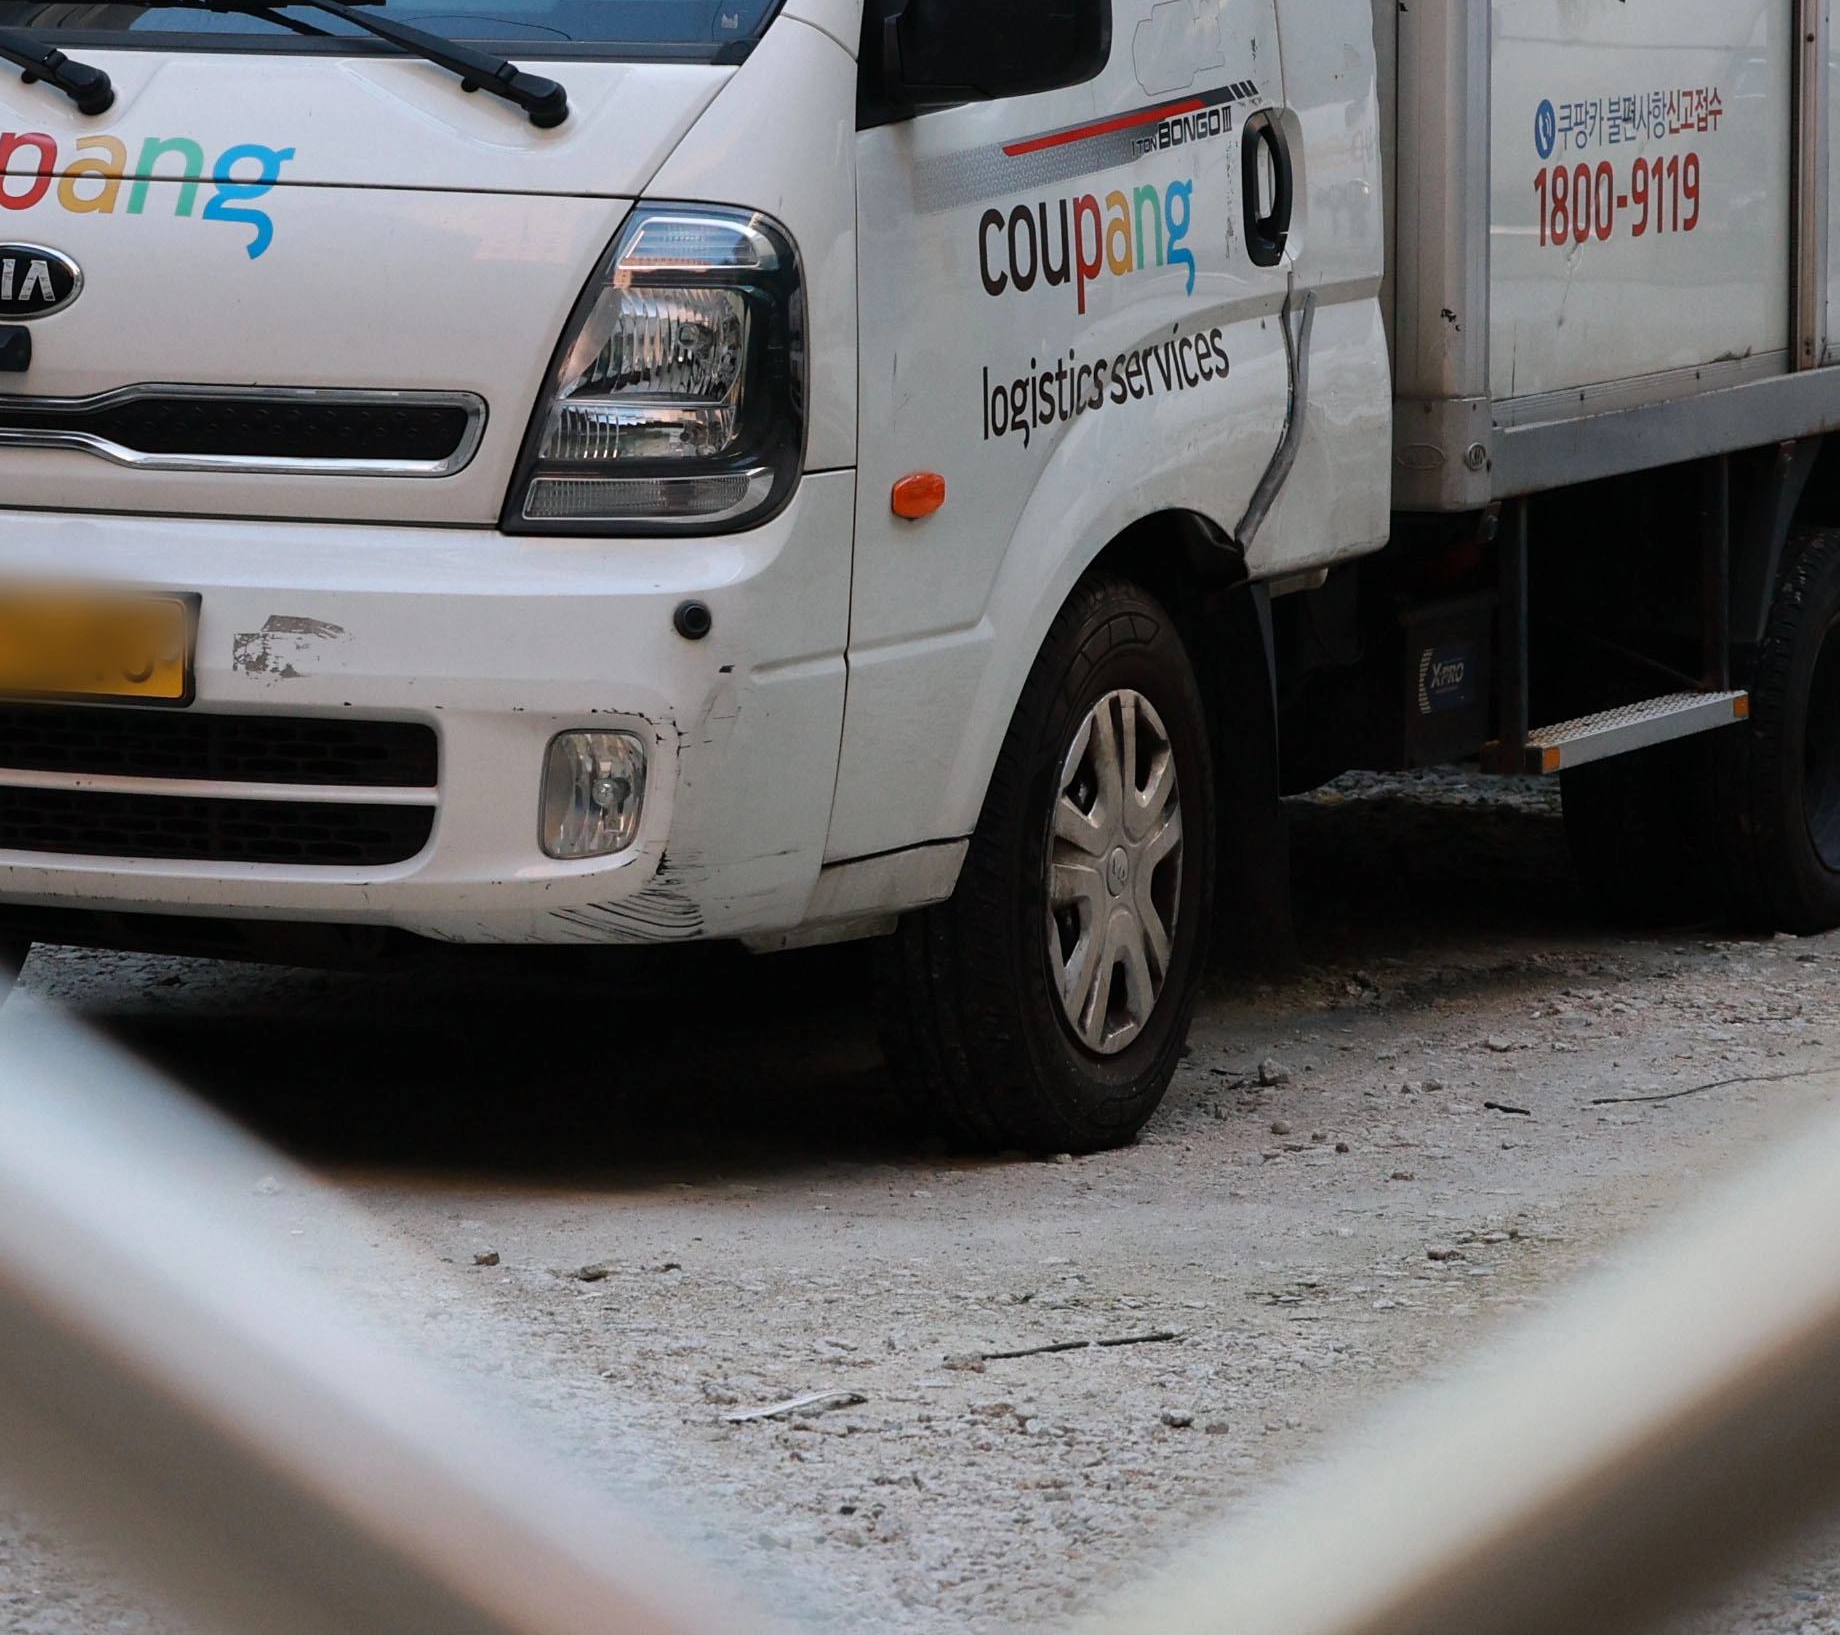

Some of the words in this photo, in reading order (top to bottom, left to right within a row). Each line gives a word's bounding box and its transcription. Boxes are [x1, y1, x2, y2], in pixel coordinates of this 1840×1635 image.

[1136, 136, 1158, 154] TON
[1158, 108, 1221, 149] BONGO
[1558, 98, 1605, 150] 쿠팡카
[978, 178, 1196, 314] coupang
[1534, 152, 1701, 246] 1800-9119
[982, 349, 1109, 450] logistics
[1110, 323, 1230, 406] services
